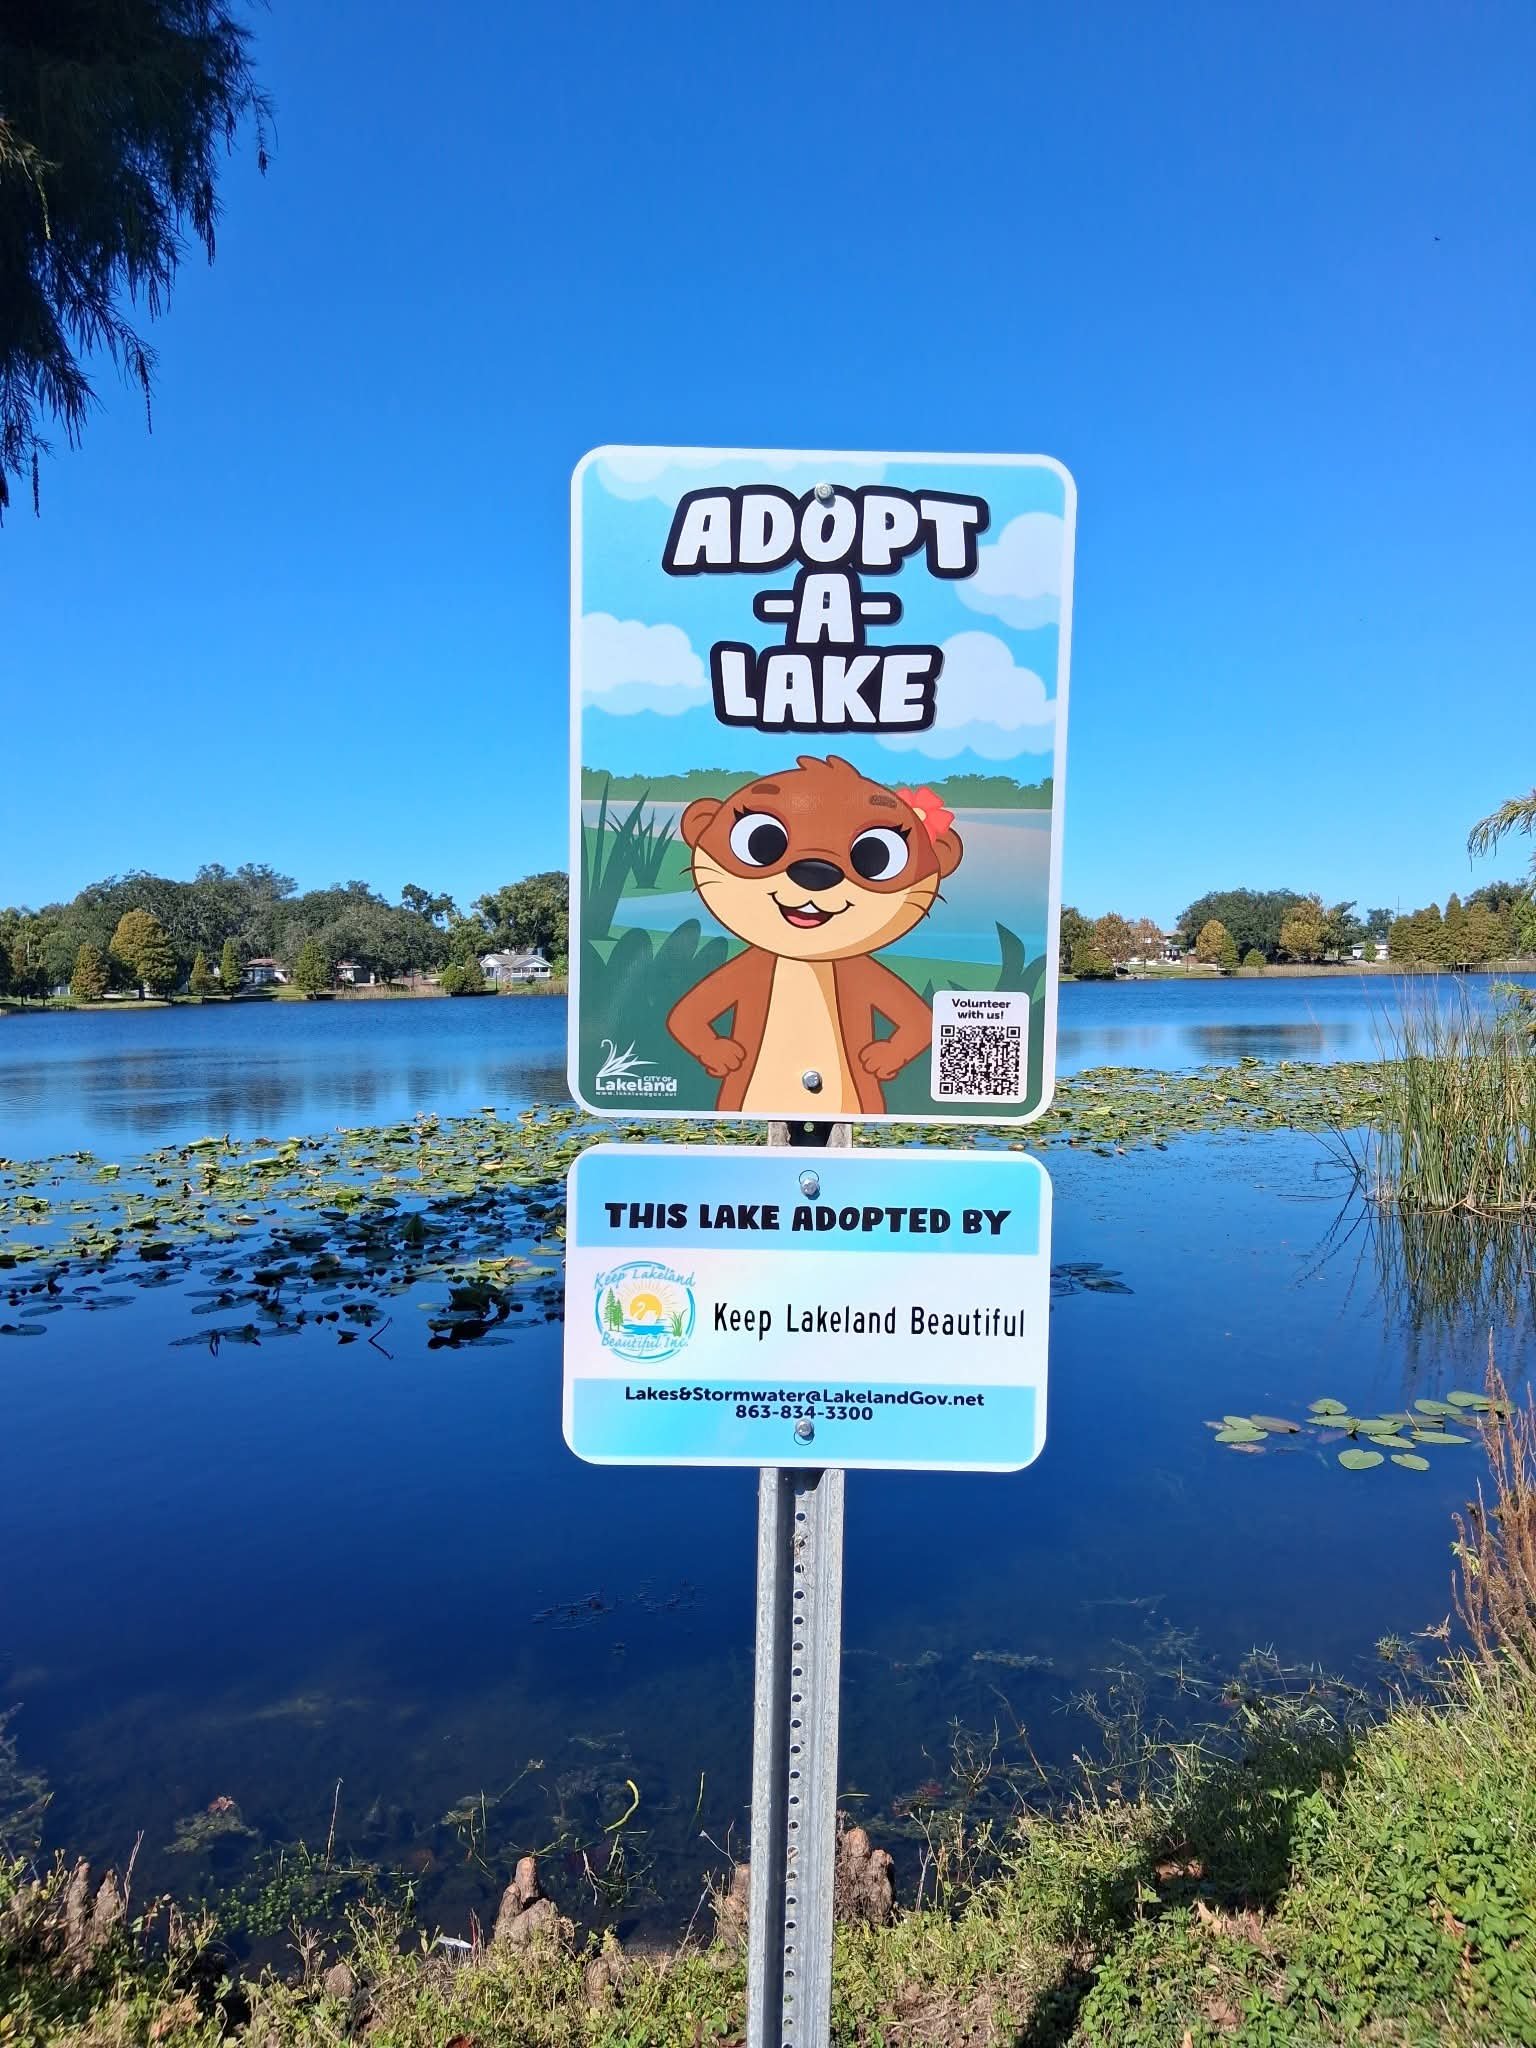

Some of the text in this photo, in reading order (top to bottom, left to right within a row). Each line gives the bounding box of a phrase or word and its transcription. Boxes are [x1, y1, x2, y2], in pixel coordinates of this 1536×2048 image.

[667, 488, 984, 573] ADOPT
[759, 569, 896, 647] -A-
[716, 646, 937, 728] LAKE
[951, 998, 1011, 1008] Volunteer
[957, 1010, 1004, 1020] with us!
[595, 1077, 677, 1092] Lakeland
[605, 1202, 1012, 1235] THIS LAKE ADOPTED BY
[594, 1264, 697, 1289] Keep Lakeland
[714, 1302, 1025, 1340] Keep Lakeland Beautiful
[601, 1331, 661, 1356] Beautiful
[625, 1386, 985, 1406] Lakes&Stormwater@LakelandGov.net
[735, 1404, 874, 1421] 863-834-3300
